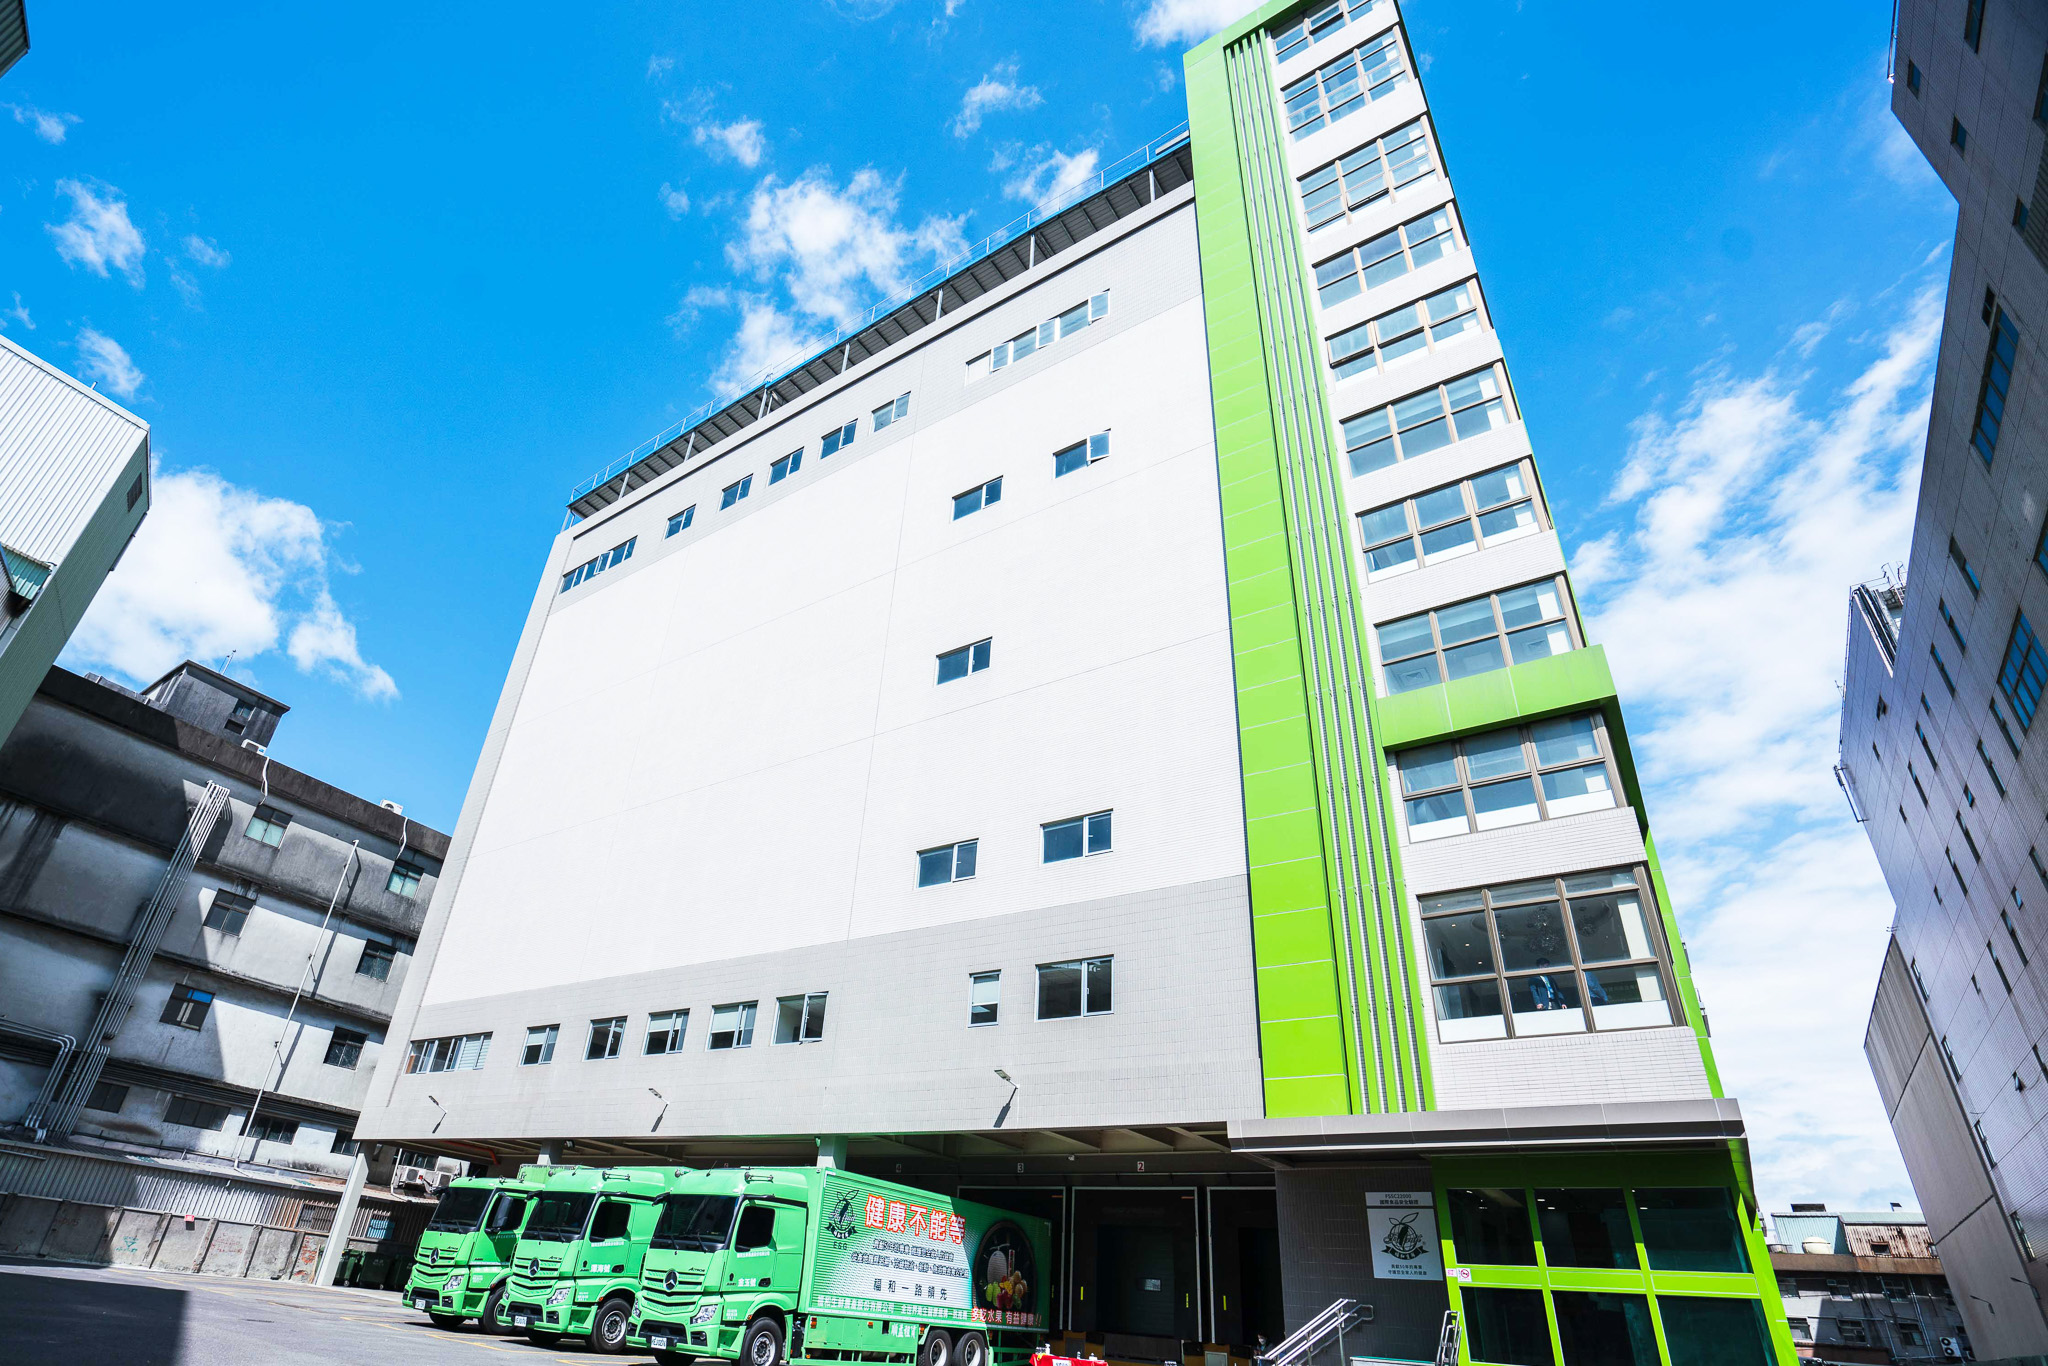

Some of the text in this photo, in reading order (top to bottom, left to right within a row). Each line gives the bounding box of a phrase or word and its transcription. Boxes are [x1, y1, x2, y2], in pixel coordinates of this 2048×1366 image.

[864, 1193, 966, 1245] 健康不能等
[971, 1305, 1003, 1323] 多吃水果
